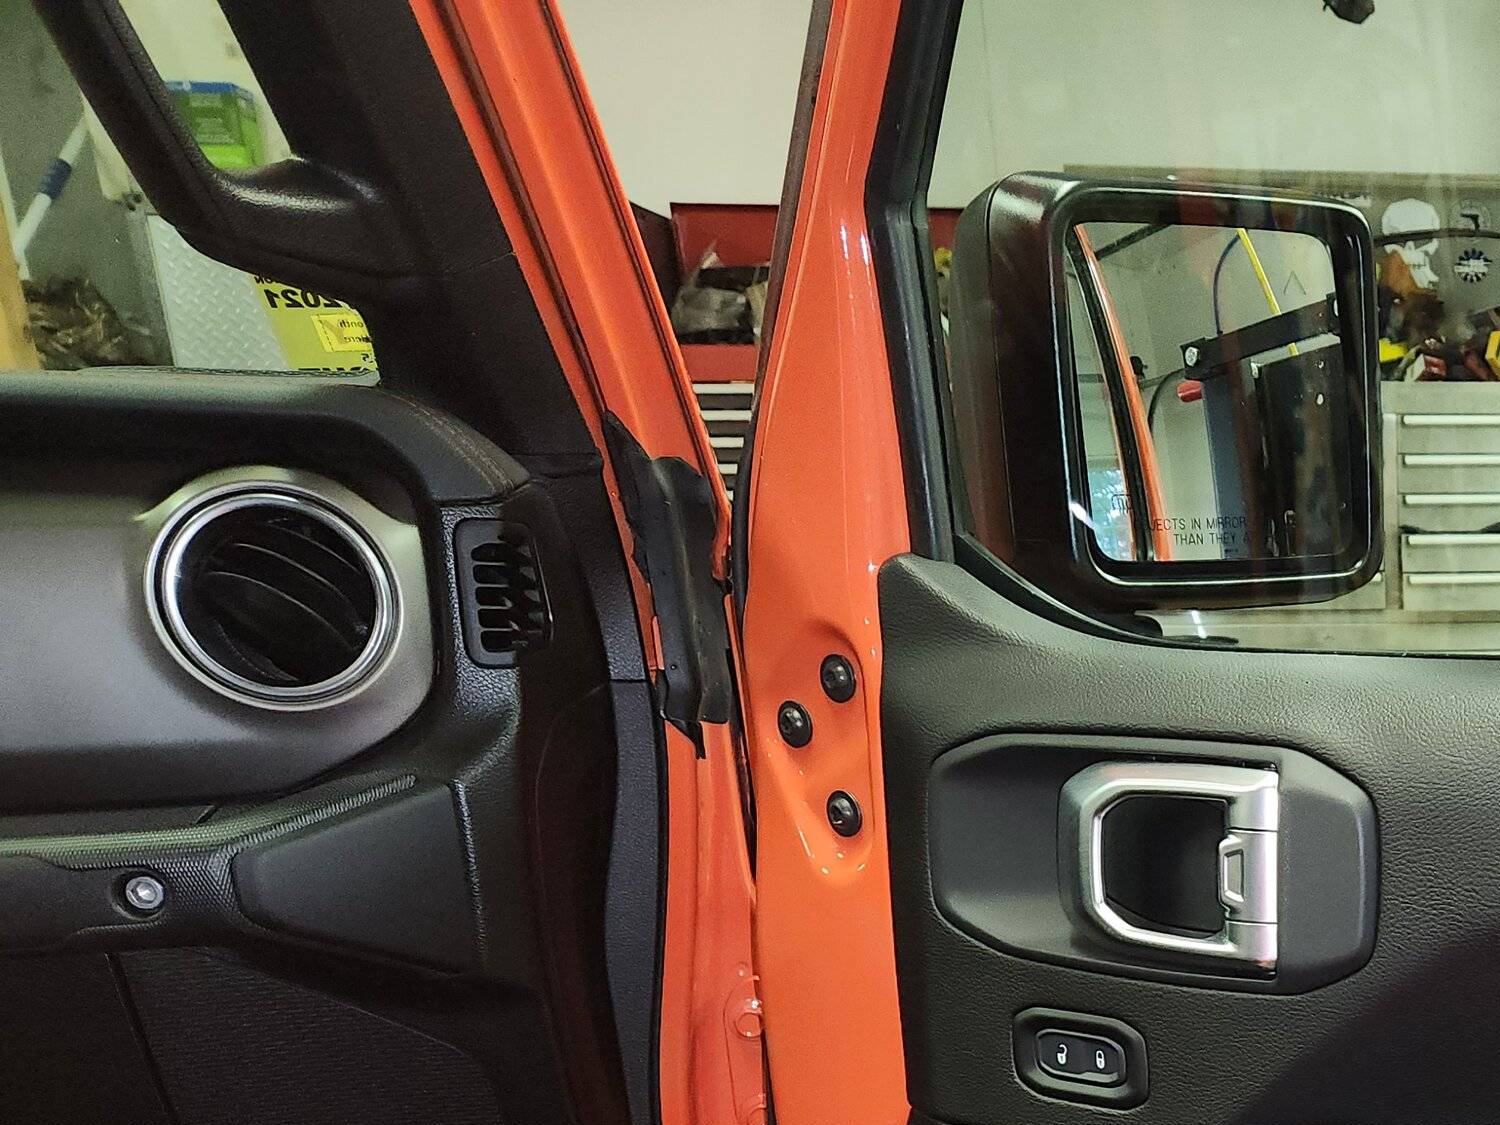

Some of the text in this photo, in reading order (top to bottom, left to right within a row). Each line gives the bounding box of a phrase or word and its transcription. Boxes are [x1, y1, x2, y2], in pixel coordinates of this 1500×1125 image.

[1144, 518, 1186, 531] JECTS
[1191, 517, 1202, 530] IN
[1173, 533, 1204, 546] THAN
[1209, 532, 1236, 545] THEY
